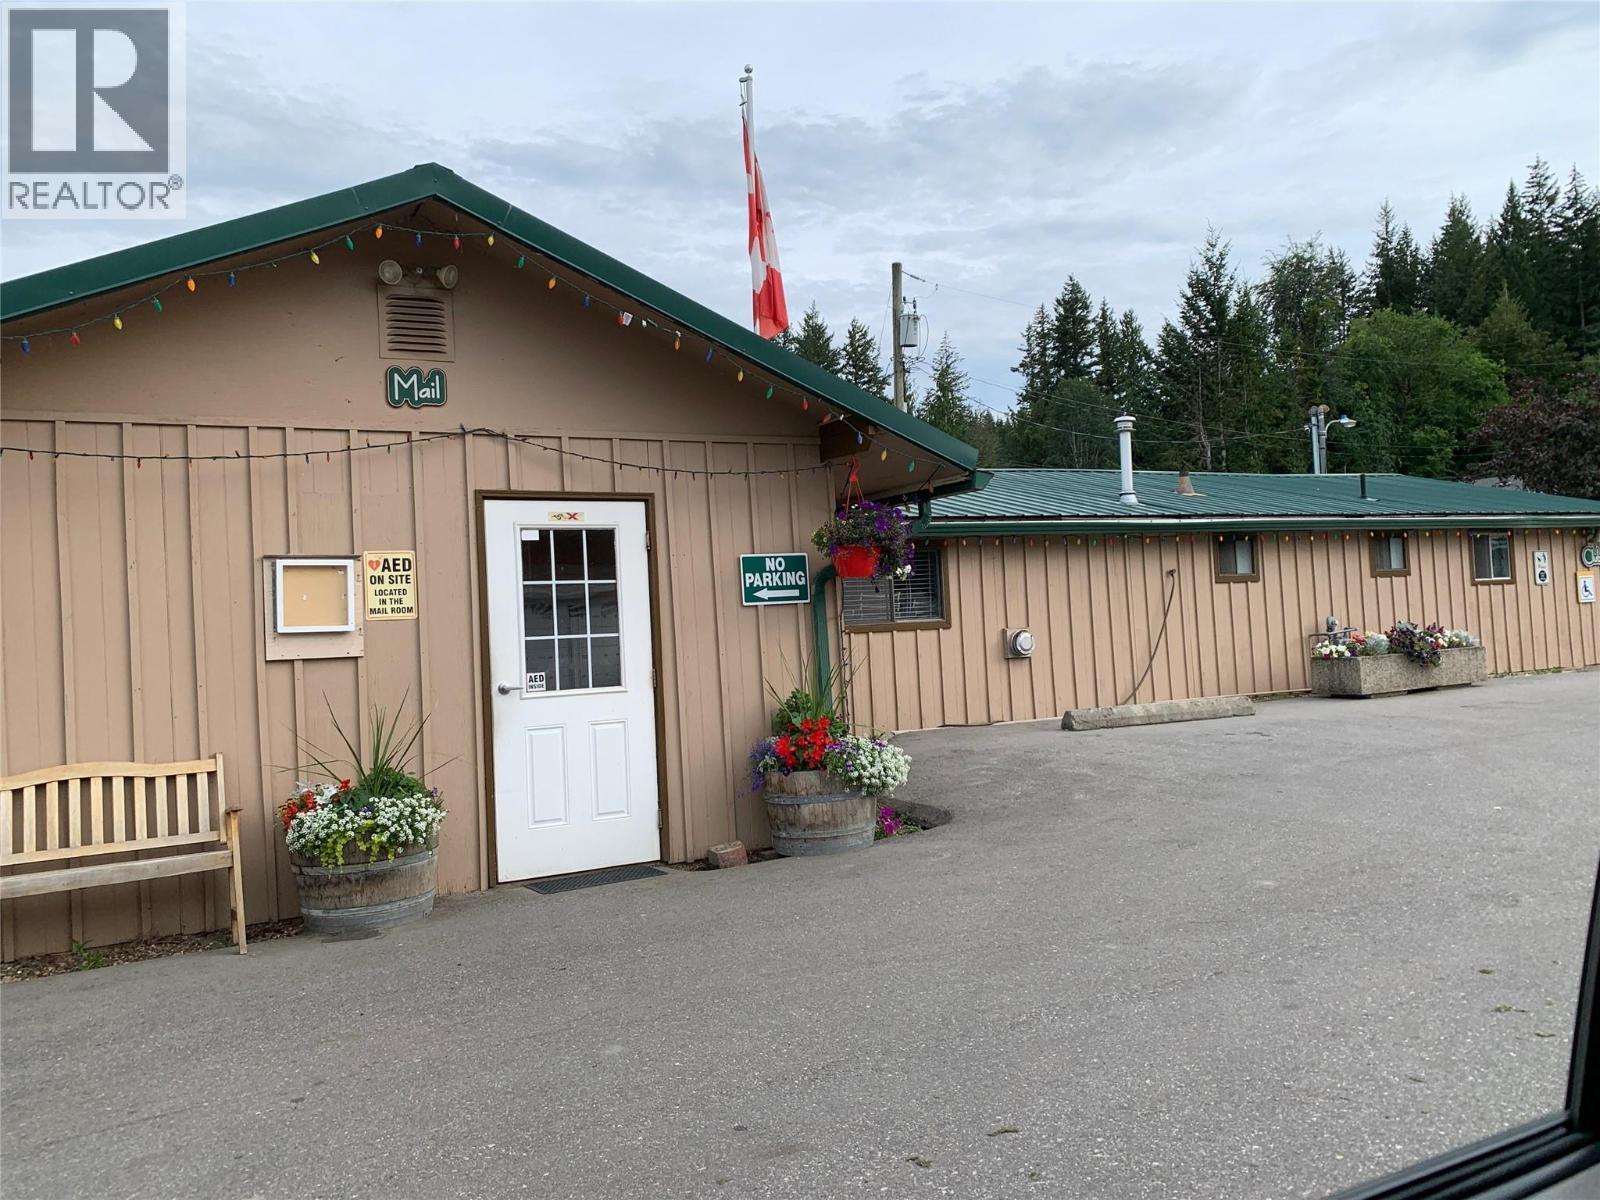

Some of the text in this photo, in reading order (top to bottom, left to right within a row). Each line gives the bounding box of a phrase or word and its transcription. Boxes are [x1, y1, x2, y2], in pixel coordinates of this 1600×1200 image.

[393, 372, 440, 401] Mail
[381, 557, 412, 573] AED
[765, 557, 786, 571] NO
[369, 574, 412, 585] ON SITE
[745, 571, 806, 587] PARKING
[374, 588, 408, 597] LOCATED
[378, 597, 404, 606] IN THE
[369, 606, 414, 615] MAIL ROOM
[528, 674, 545, 683] AED
